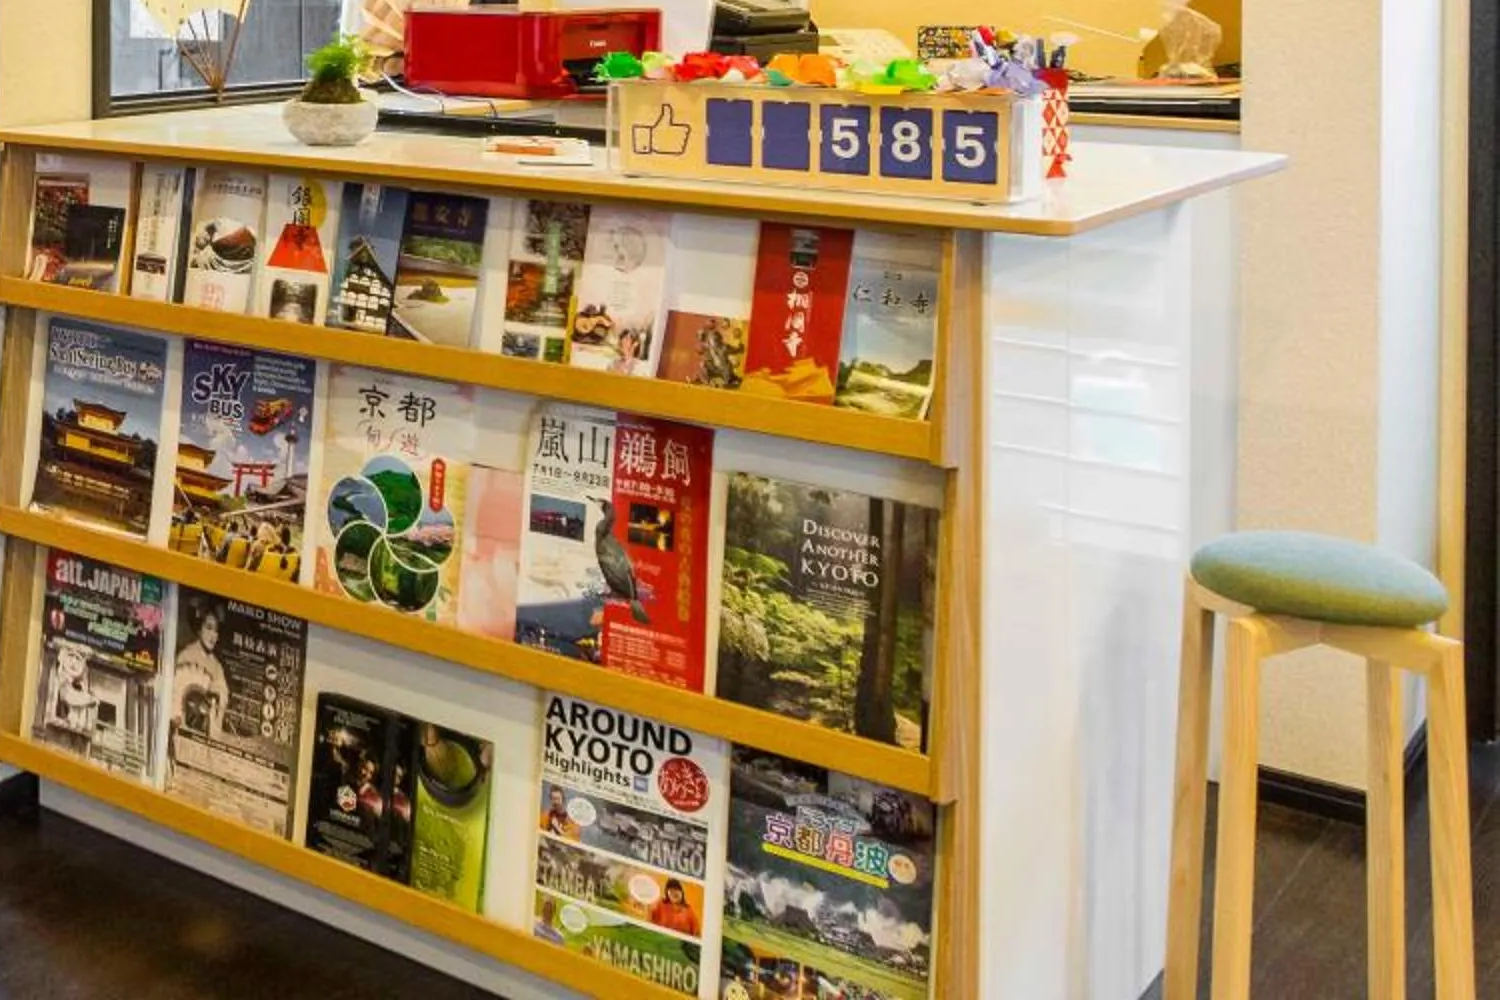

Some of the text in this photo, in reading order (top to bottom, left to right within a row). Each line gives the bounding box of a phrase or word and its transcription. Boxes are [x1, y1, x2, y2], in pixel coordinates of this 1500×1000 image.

[192, 363, 250, 404] SKY
[209, 399, 244, 420] BUS
[358, 384, 437, 428] 京都
[535, 417, 611, 468] 嵐山
[801, 539, 880, 567] ANOTHER
[802, 519, 881, 549] DISCOVER
[801, 558, 880, 588] KYOTO
[546, 696, 692, 756] AROUND
[544, 751, 631, 788] Highlights
[545, 723, 654, 776] KYOTO
[763, 812, 890, 878] 京都丹波
[592, 935, 698, 991] YAMASHIRO
